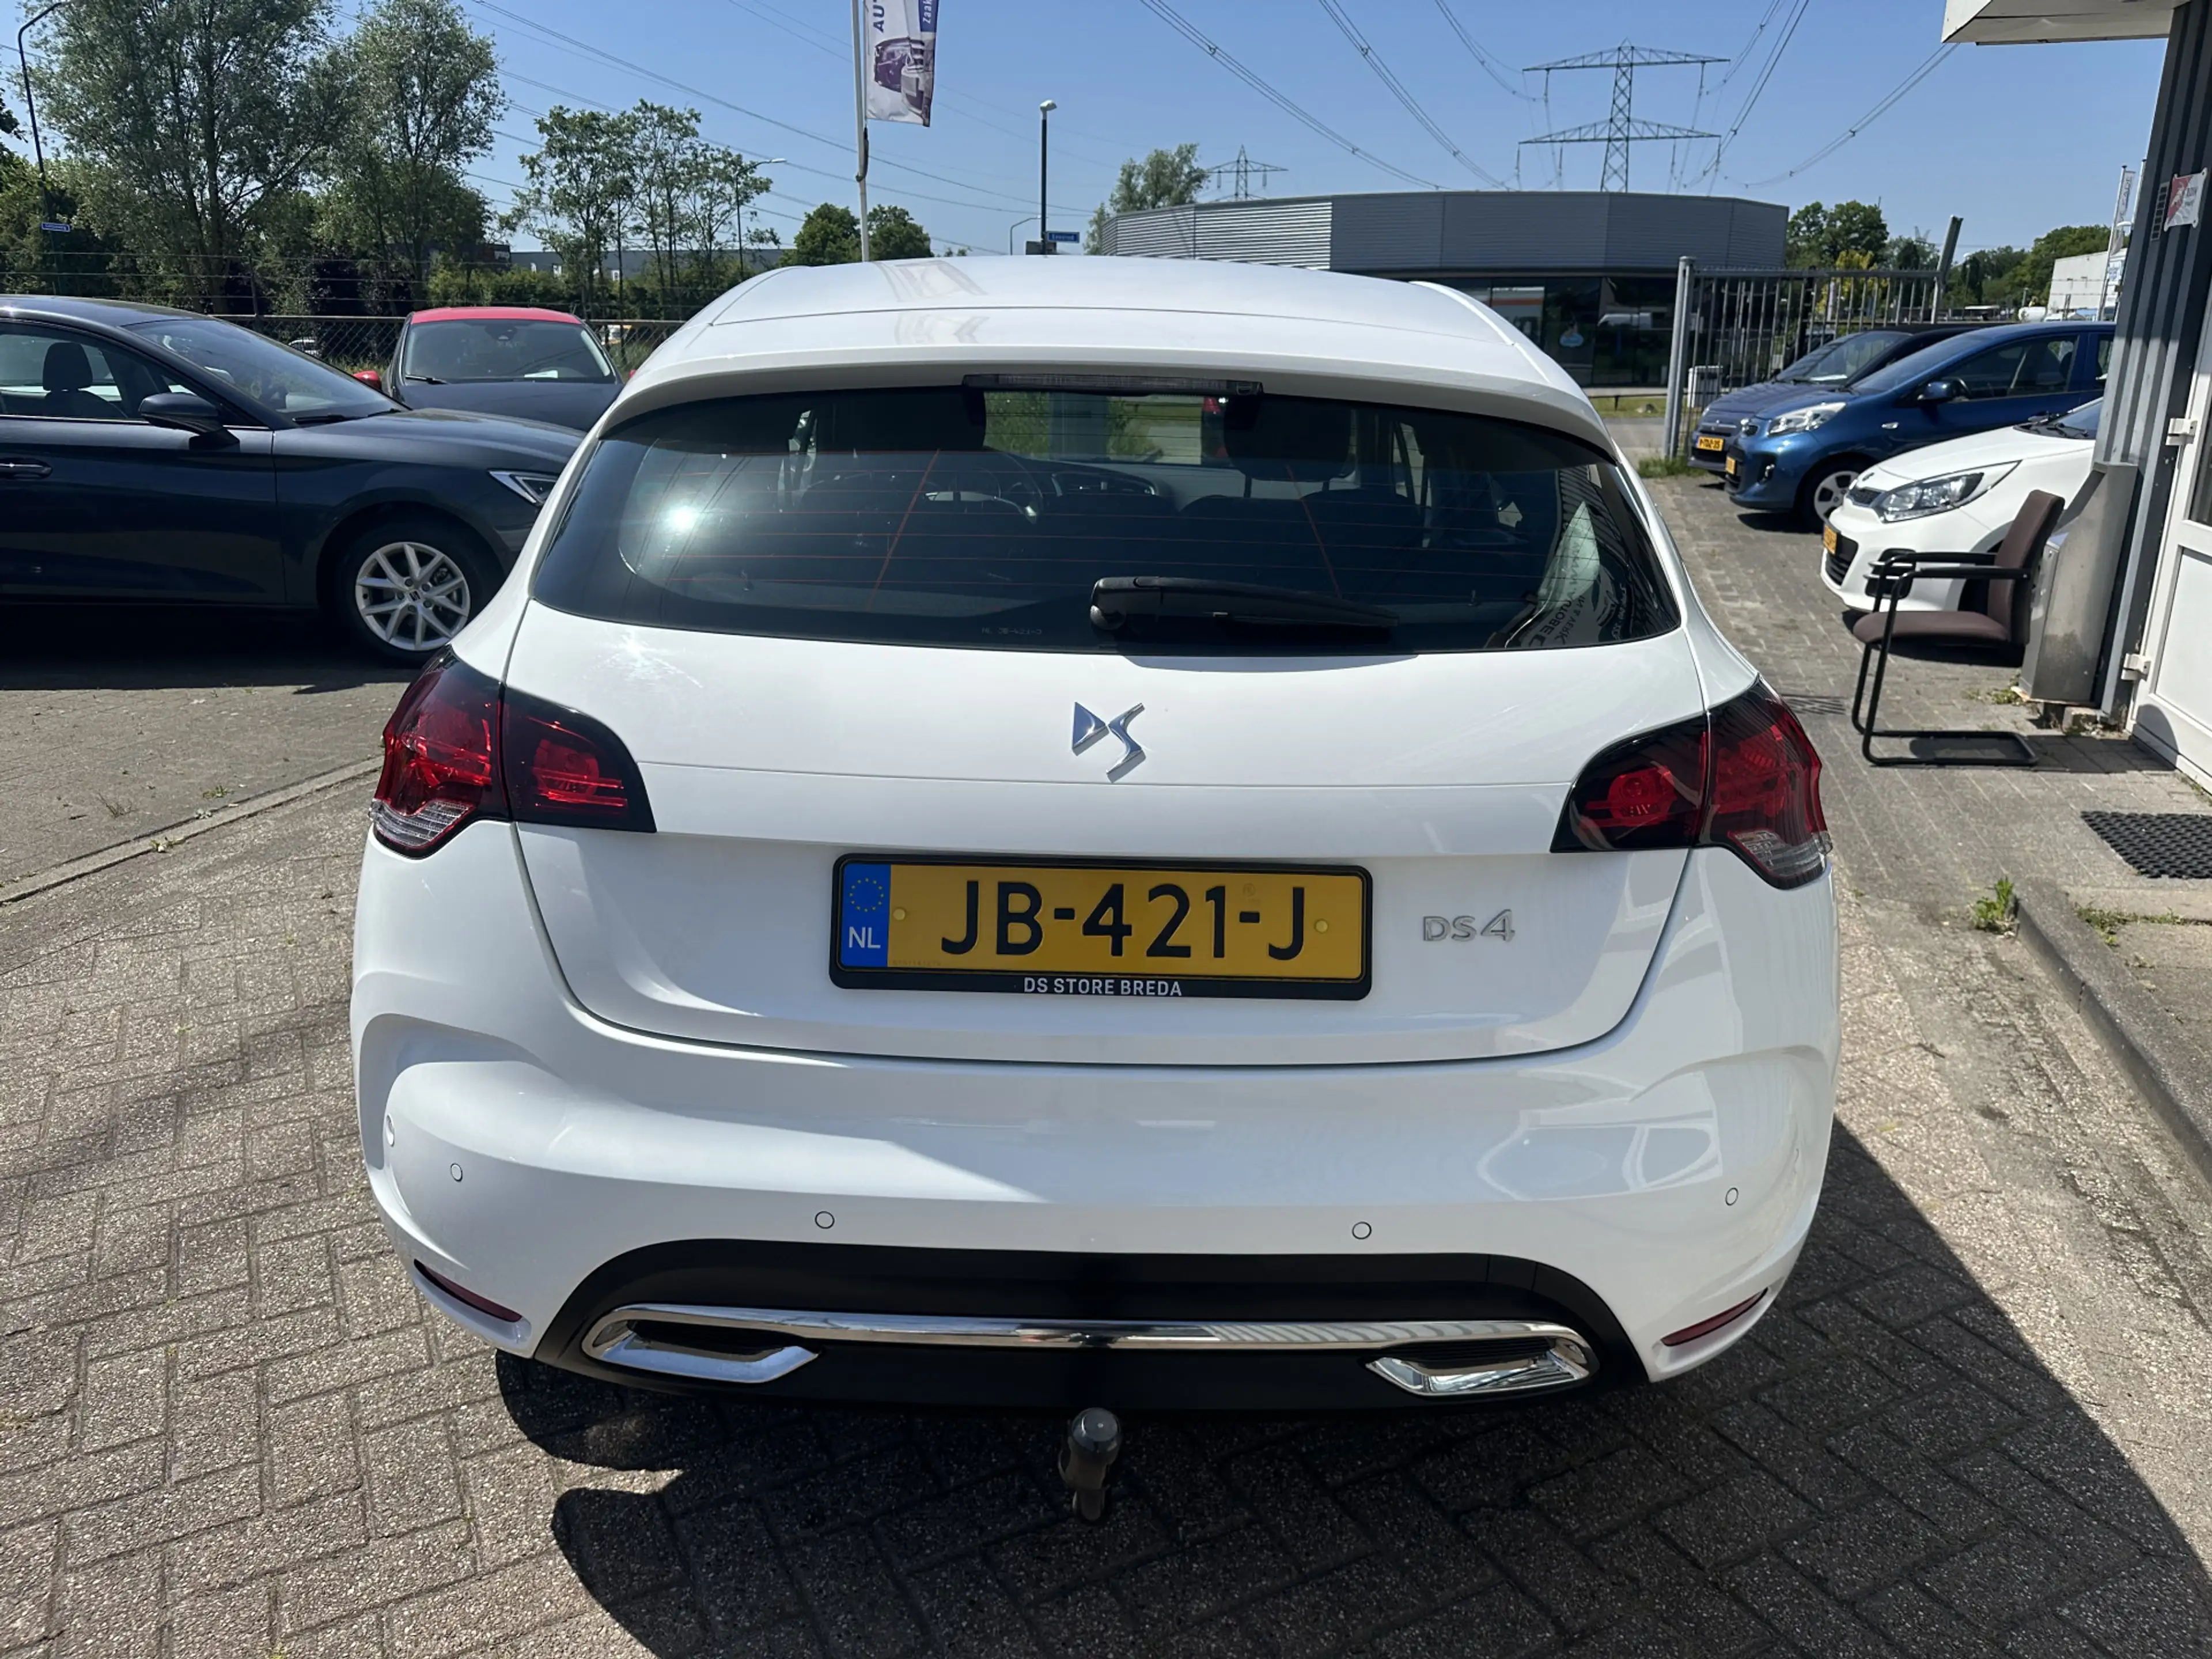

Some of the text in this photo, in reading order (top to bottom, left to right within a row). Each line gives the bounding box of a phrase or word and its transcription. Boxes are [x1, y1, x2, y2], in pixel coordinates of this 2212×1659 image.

[873, 0, 885, 33] AU
[941, 880, 1305, 960] JB-421-J
[1423, 908, 1516, 942] DS4
[849, 926, 881, 949] NL
[1024, 977, 1182, 997] DS STORE BREDA
